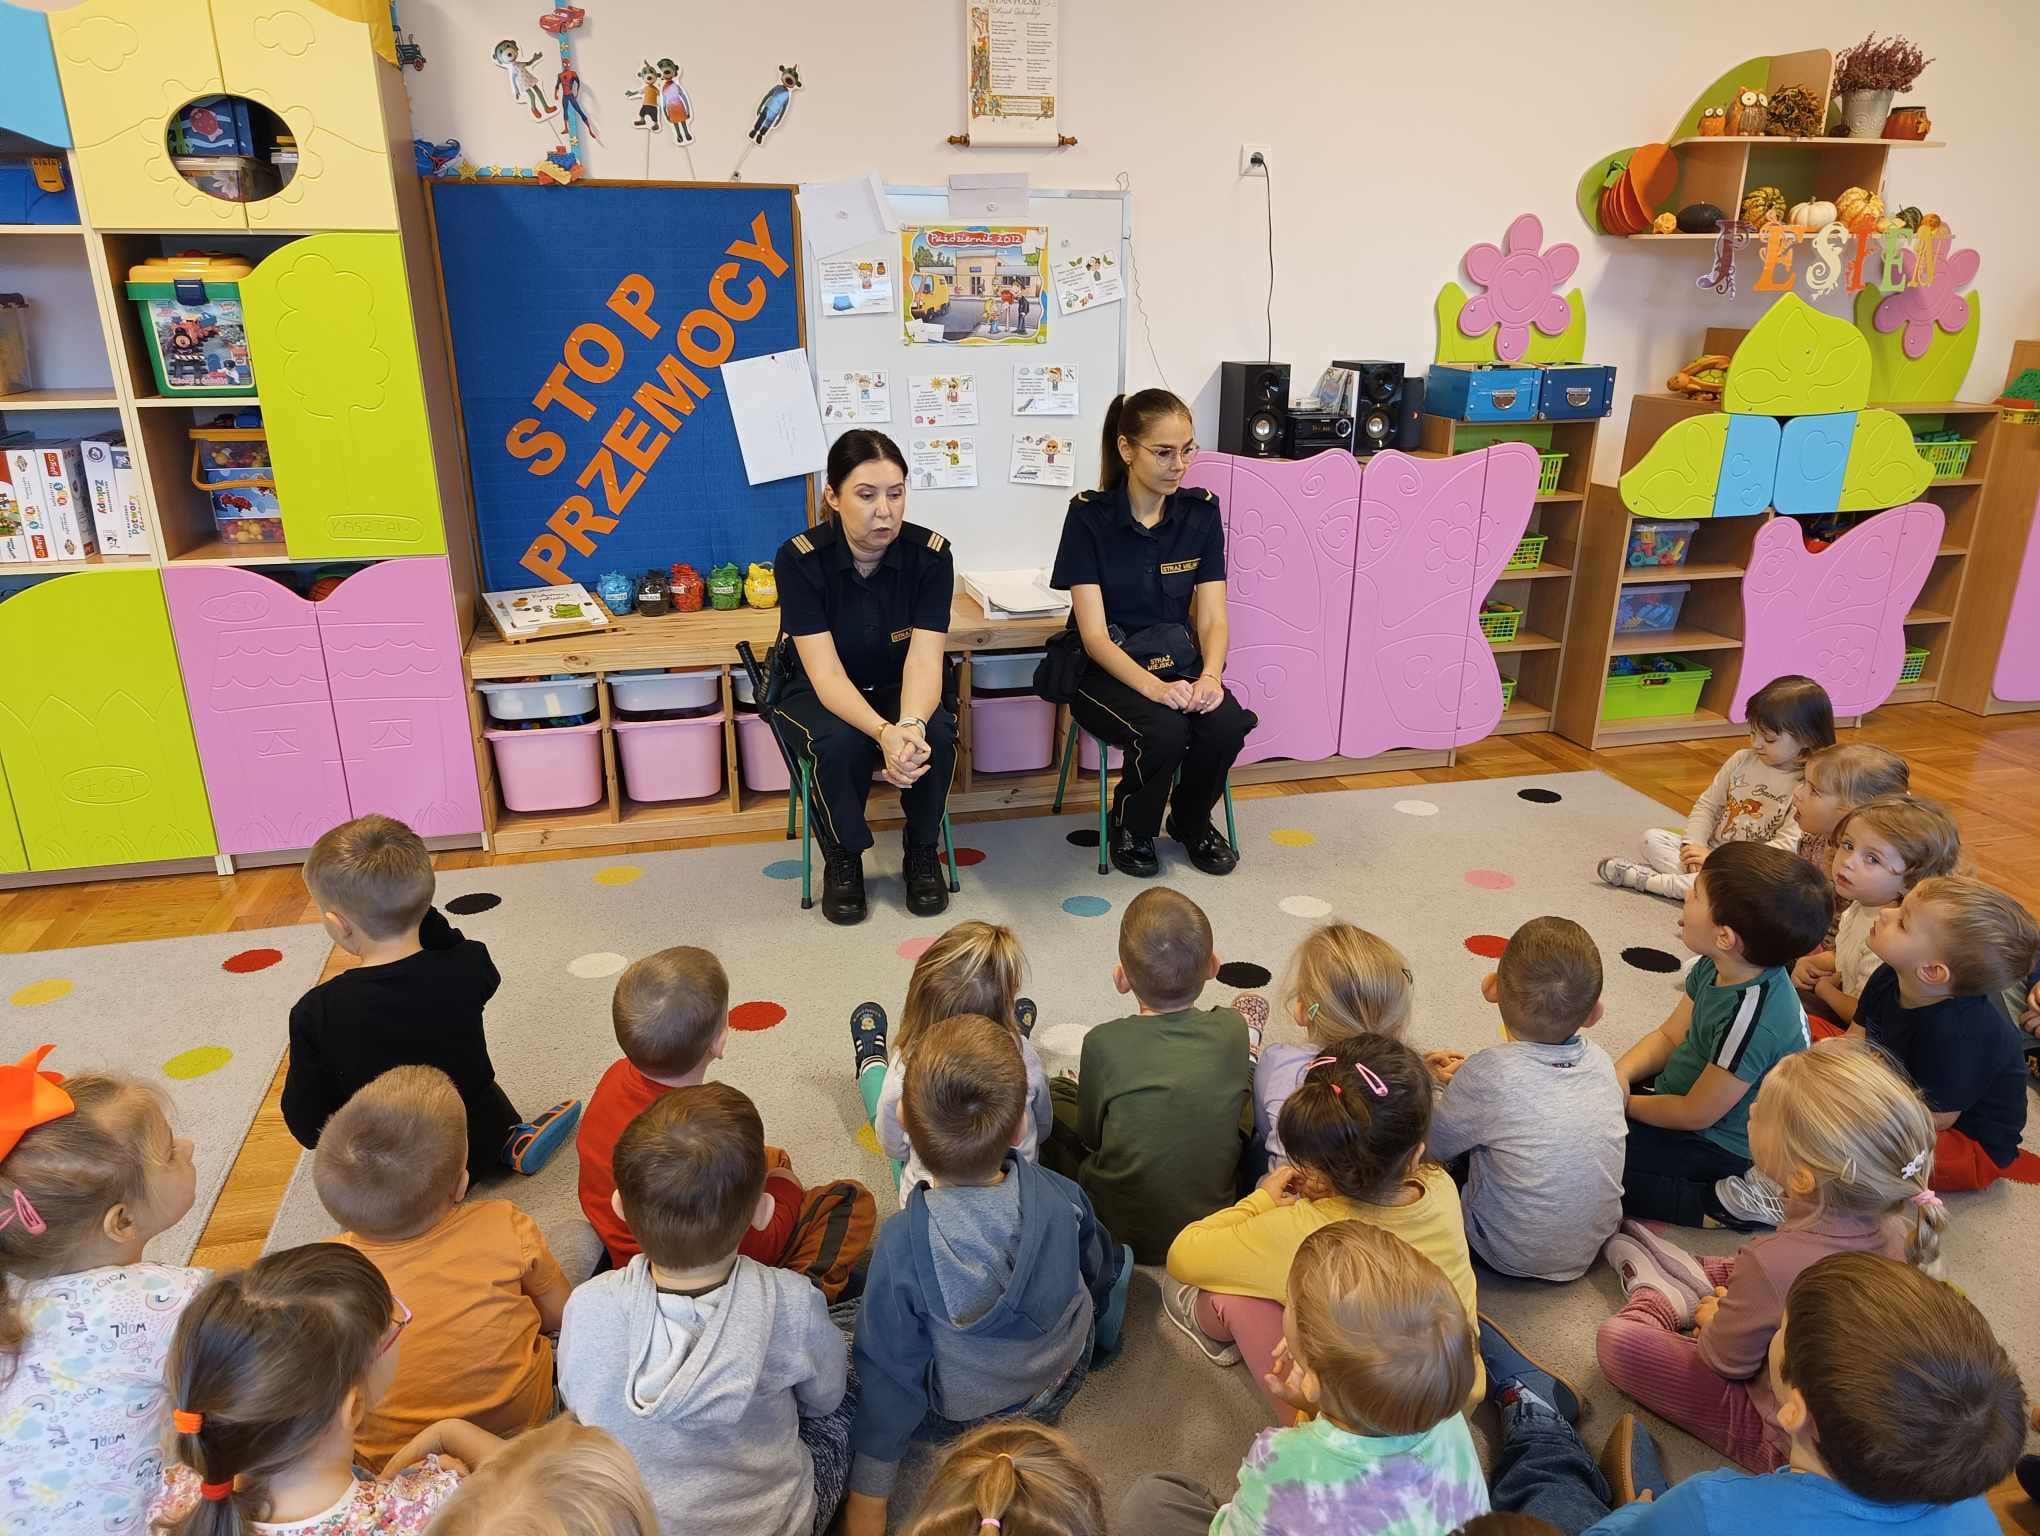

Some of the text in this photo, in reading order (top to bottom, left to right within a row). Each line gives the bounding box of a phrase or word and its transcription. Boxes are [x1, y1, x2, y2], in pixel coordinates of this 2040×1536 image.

[997, 234, 1021, 244] 2012
[505, 273, 661, 477] STOP
[518, 210, 789, 585] PRZEMOCY
[95, 479, 107, 514] Zakupy
